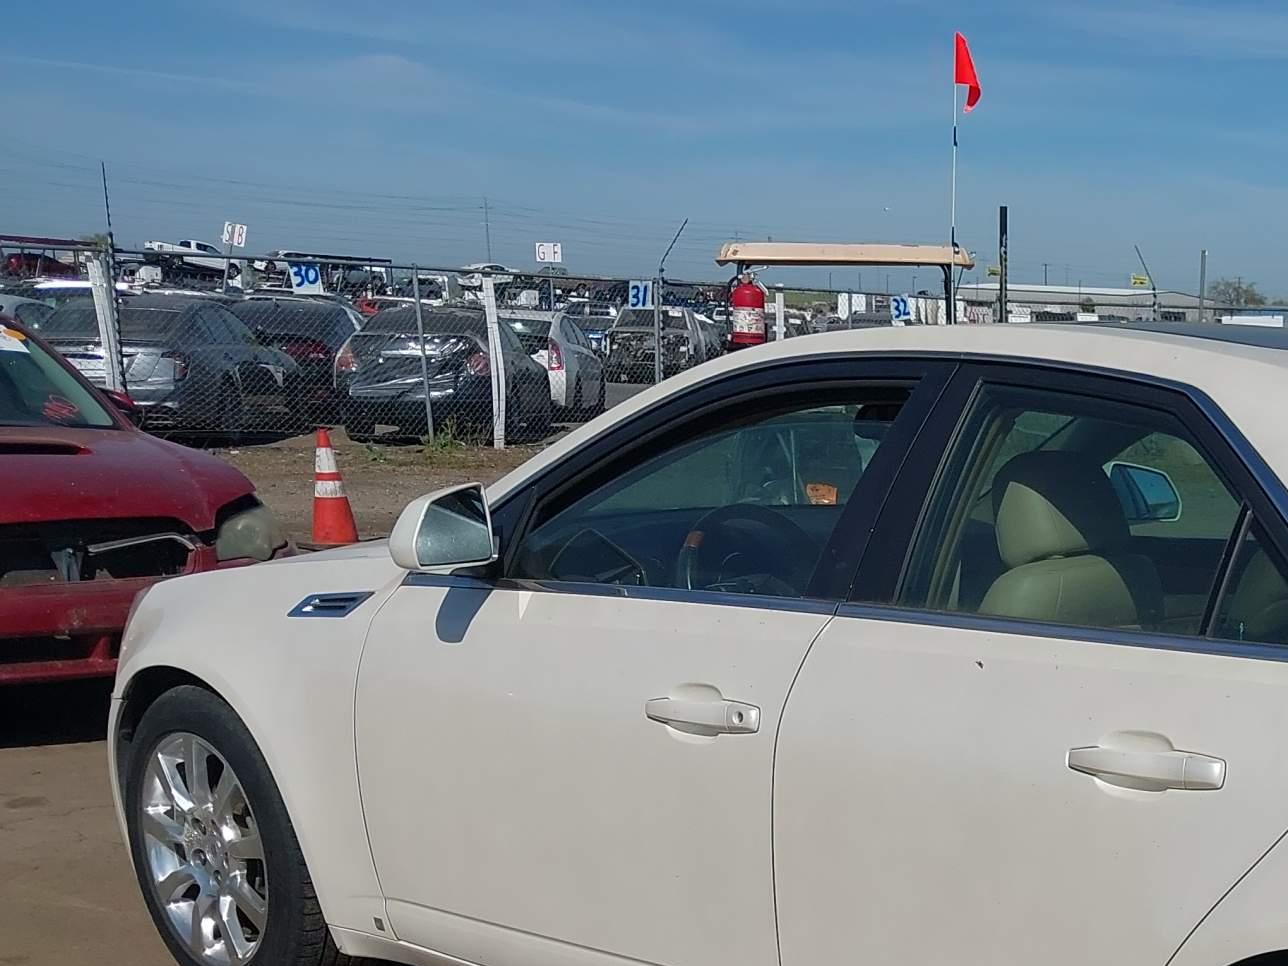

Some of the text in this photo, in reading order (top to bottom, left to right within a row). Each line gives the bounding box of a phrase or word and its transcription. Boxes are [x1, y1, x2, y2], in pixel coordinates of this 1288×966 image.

[537, 243, 559, 261] G F
[293, 264, 319, 287] 30
[630, 285, 648, 307] 31
[892, 298, 910, 318] 32
